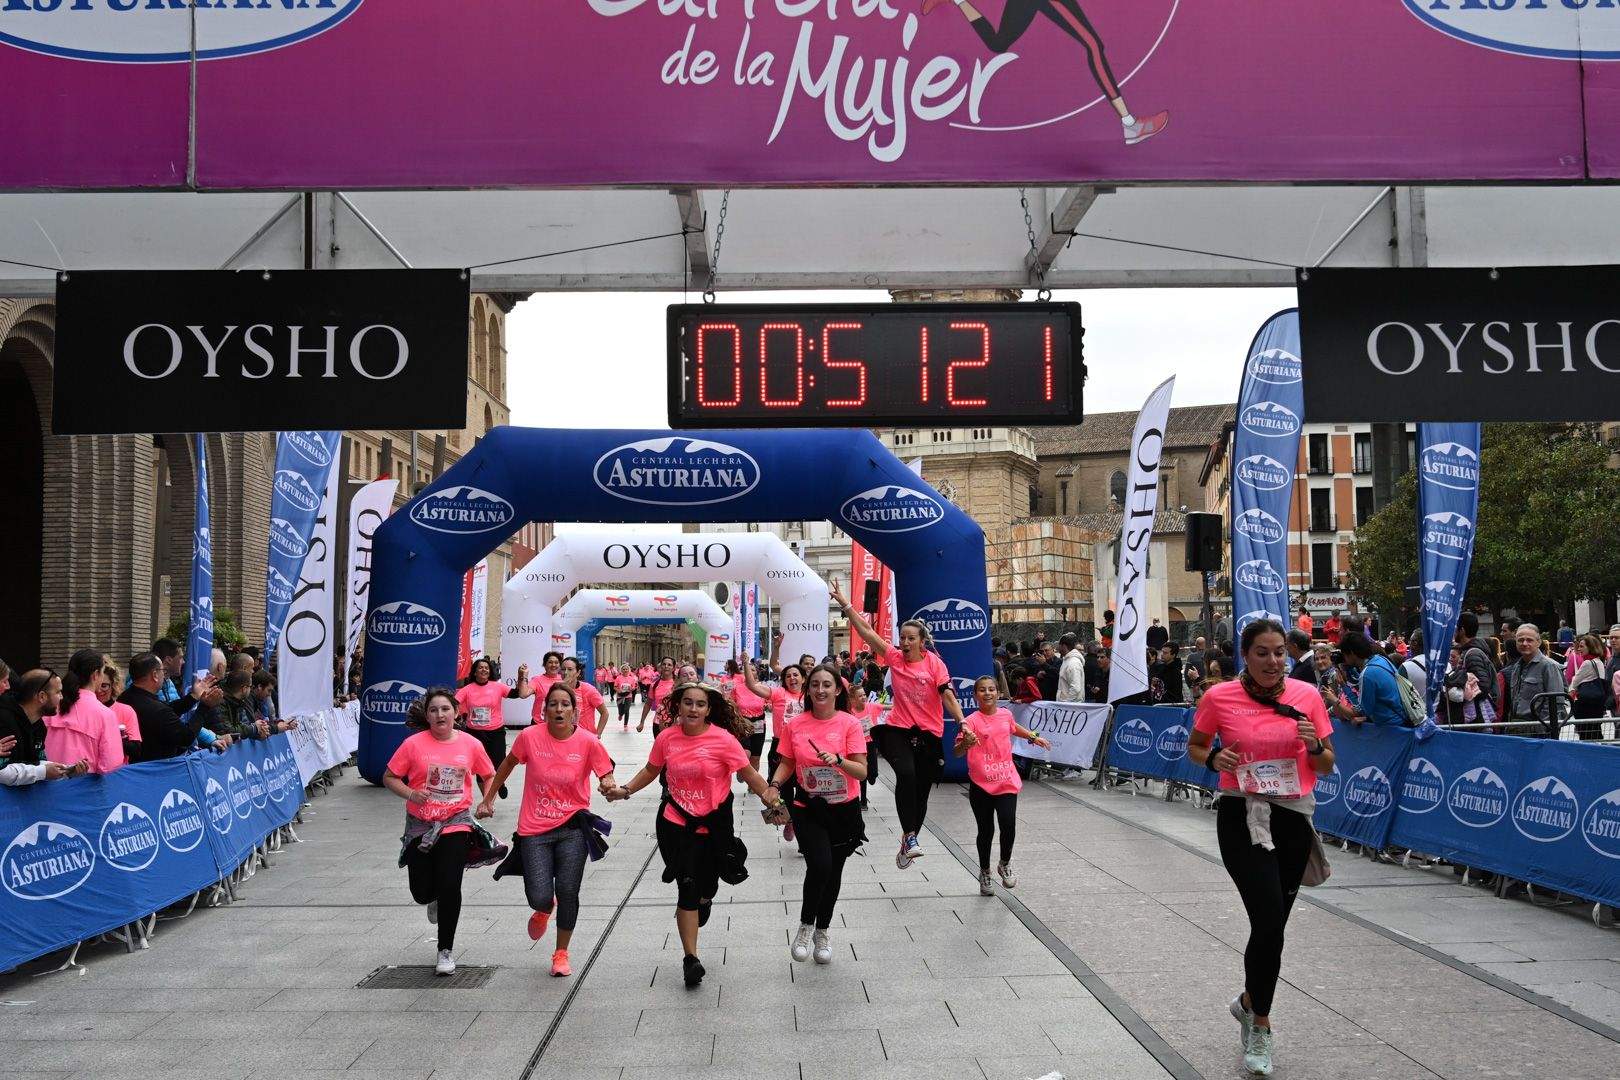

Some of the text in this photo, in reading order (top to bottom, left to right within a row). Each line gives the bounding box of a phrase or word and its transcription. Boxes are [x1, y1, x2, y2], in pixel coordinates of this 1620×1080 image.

[661, 13, 1019, 162] de la Mujer
[122, 322, 410, 380] OYSHO
[1253, 362, 1302, 378] ASTURIANA
[1245, 411, 1294, 431] ASTURIANA
[632, 456, 743, 466] CENTRAL LECHERA
[1424, 455, 1476, 481] ASTURIAN
[606, 458, 749, 488] ASTURIANA
[1240, 464, 1284, 484] ASTURIANA
[275, 474, 315, 508] ASTURIANA
[416, 502, 507, 523] ASTURIANA
[849, 504, 939, 522] ASTURIANA
[270, 528, 303, 555] STURIANA
[602, 542, 732, 569] OYSHO
[525, 573, 565, 582] OYSHO
[767, 569, 805, 579] OYSHO
[369, 615, 440, 635] ASTURIANA
[507, 624, 544, 634] OYSHO
[787, 622, 823, 632] OYSHO
[925, 618, 985, 632] STURIANA
[362, 694, 412, 713] ASTURI
[1029, 707, 1088, 736] OYSHO
[984, 761, 1013, 772] DORSA
[817, 779, 833, 787] 016
[1260, 780, 1280, 789] 016
[1403, 782, 1440, 803] TURIANA
[1451, 784, 1503, 816] ASTURIANA
[419, 807, 448, 816] SUMA
[1515, 796, 1572, 830] ASTURIANA
[163, 813, 203, 841] ASTURIANA
[107, 829, 157, 860] ASTURIANA
[11, 849, 91, 889] ASTURIANA
